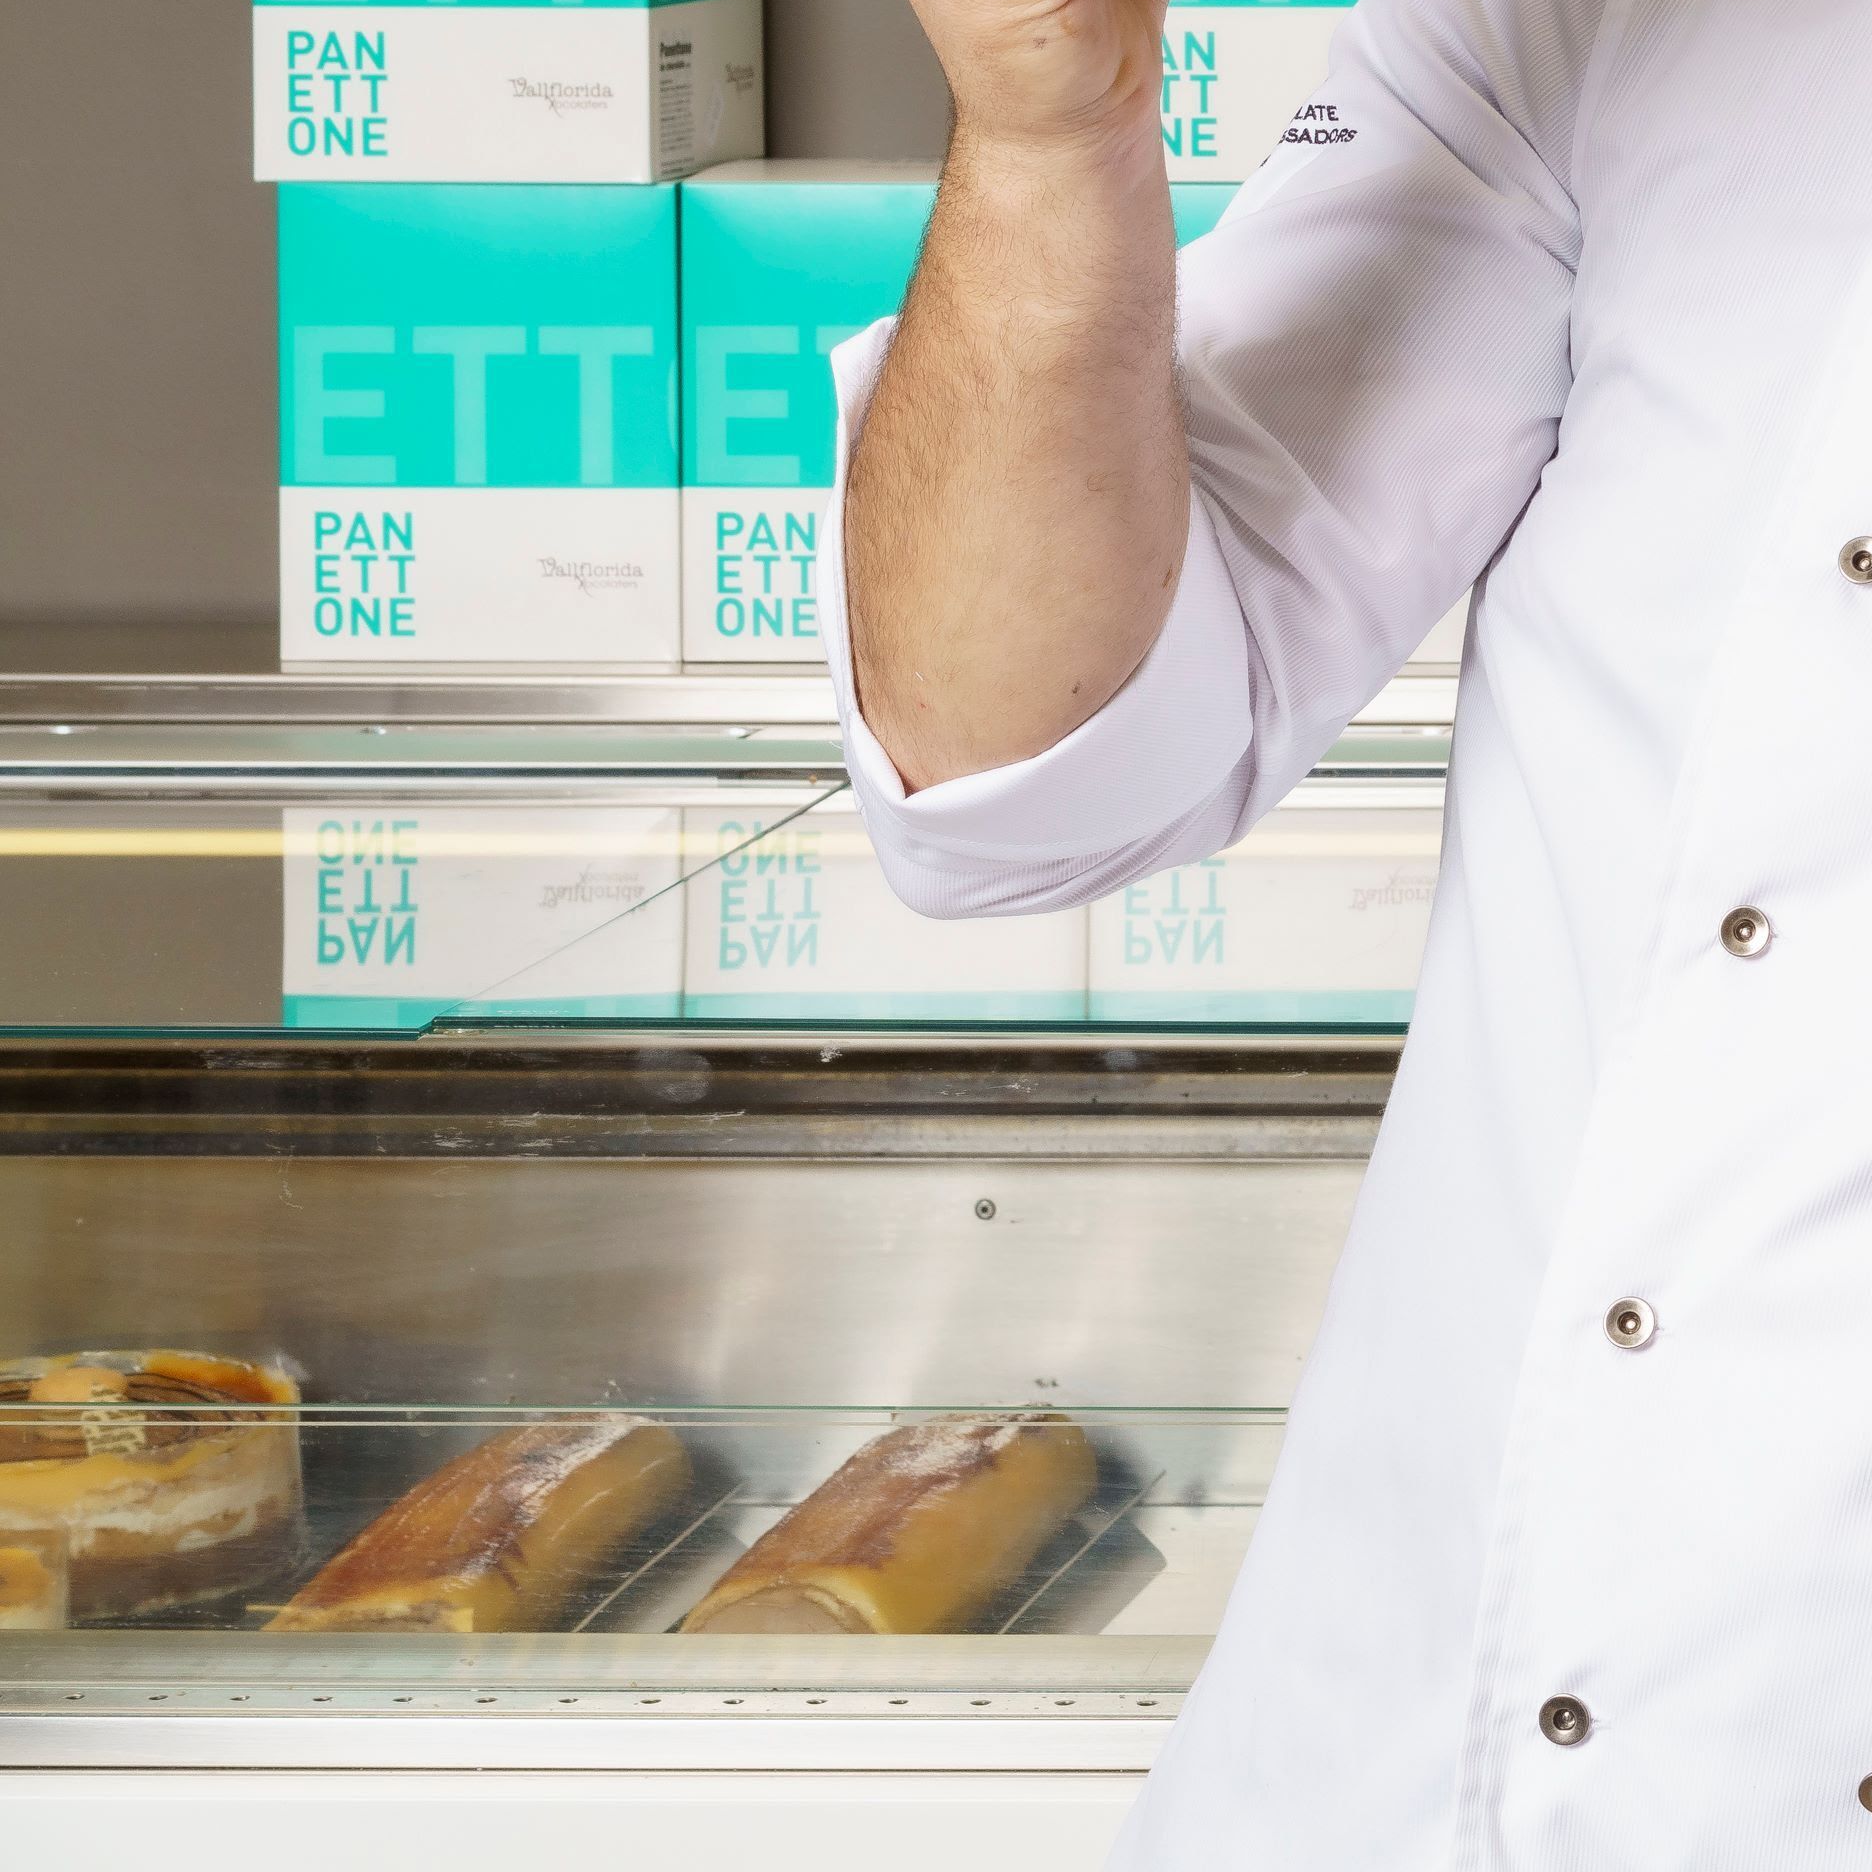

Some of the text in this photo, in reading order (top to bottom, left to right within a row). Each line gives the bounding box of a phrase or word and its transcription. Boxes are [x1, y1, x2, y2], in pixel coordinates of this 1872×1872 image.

[288, 31, 385, 69] PAN
[288, 74, 388, 112] ETT
[1162, 75, 1218, 113] TT
[288, 117, 388, 156] ONE
[1161, 118, 1218, 156] NE
[295, 326, 654, 485] ETT
[314, 512, 413, 550] PAN
[716, 512, 817, 550] PAN
[314, 555, 415, 593] ETT
[716, 555, 818, 593] ETT
[313, 598, 415, 636] ONE
[715, 598, 818, 636] ONE
